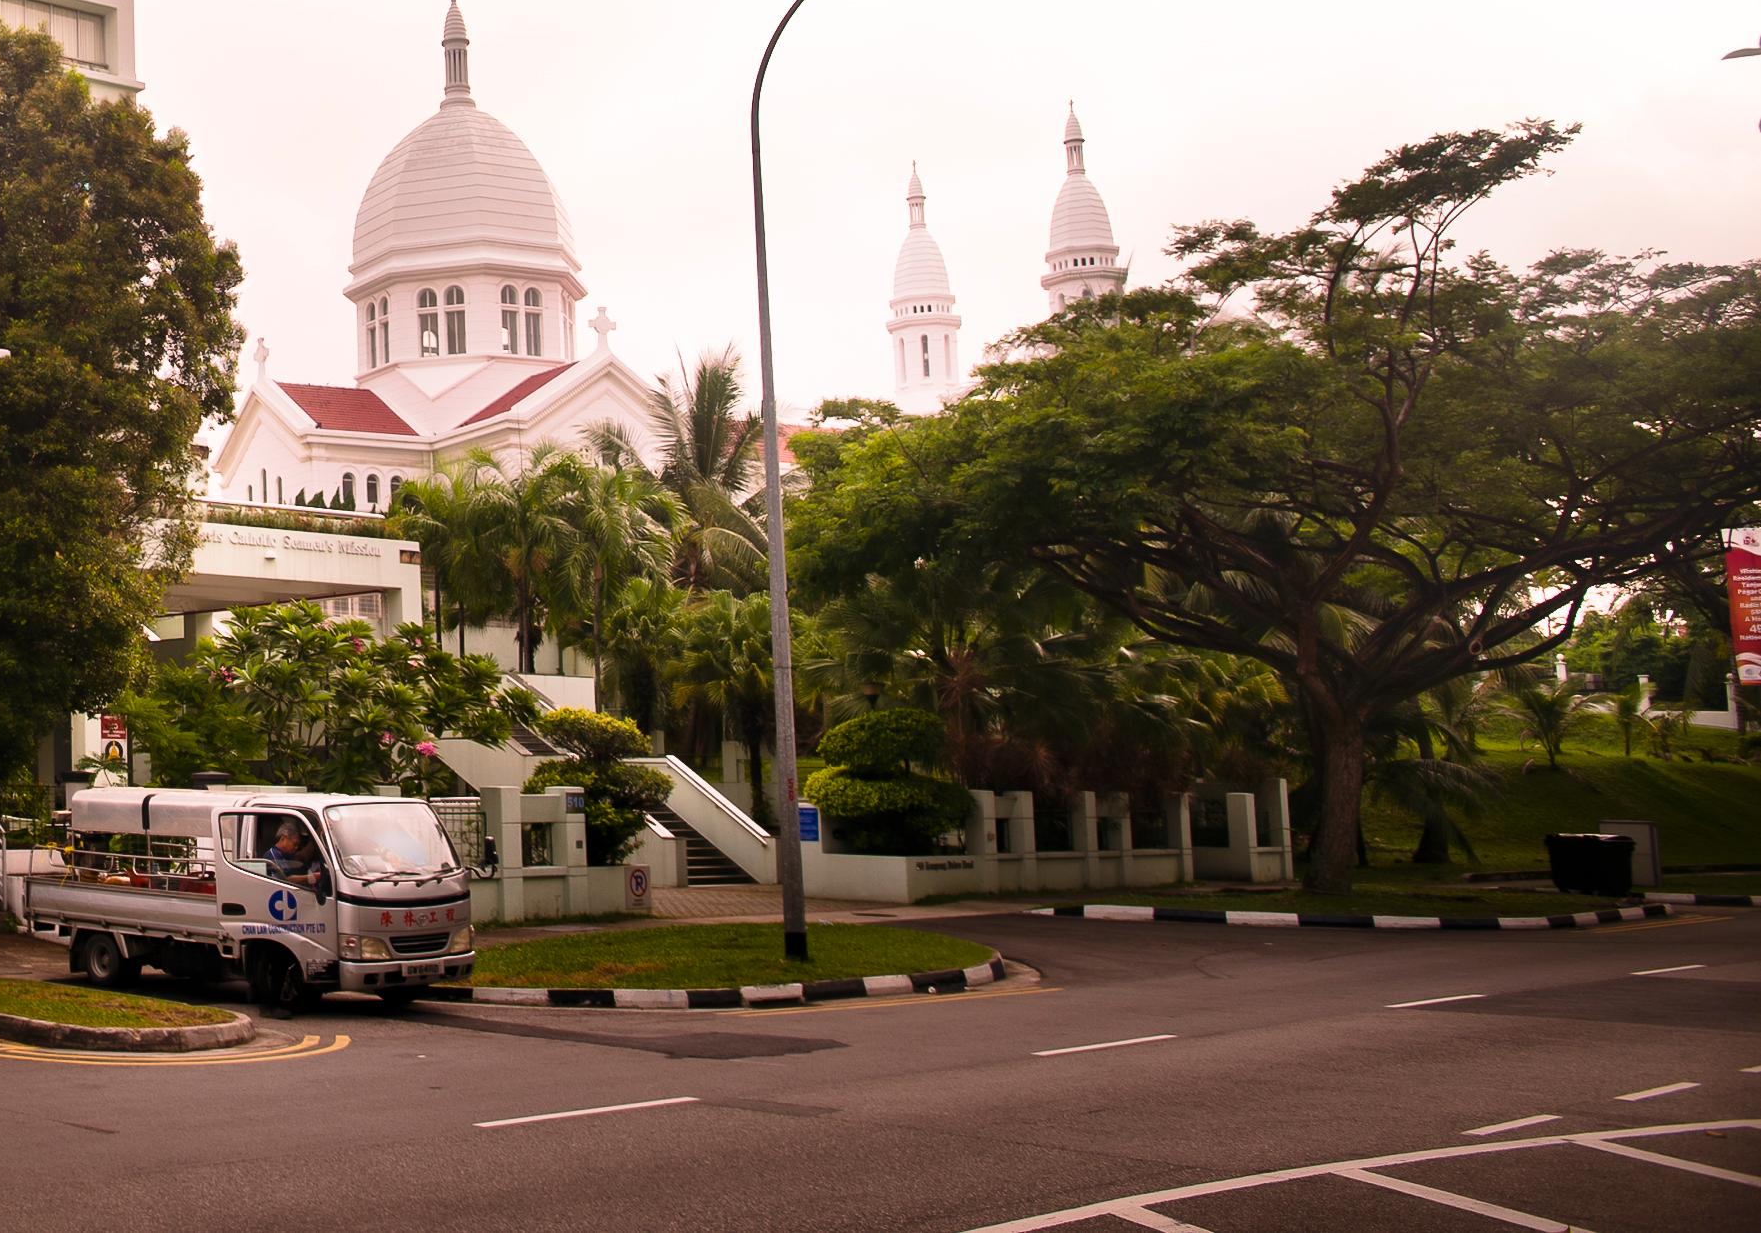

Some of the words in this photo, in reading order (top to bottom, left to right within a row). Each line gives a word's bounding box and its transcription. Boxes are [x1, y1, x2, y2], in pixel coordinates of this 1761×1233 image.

[229, 530, 276, 549] Catholic
[283, 535, 334, 553] Seamen's
[338, 540, 382, 558] Mission
[567, 796, 584, 808] 510
[306, 923, 316, 934] PTE
[316, 922, 326, 934] LTD
